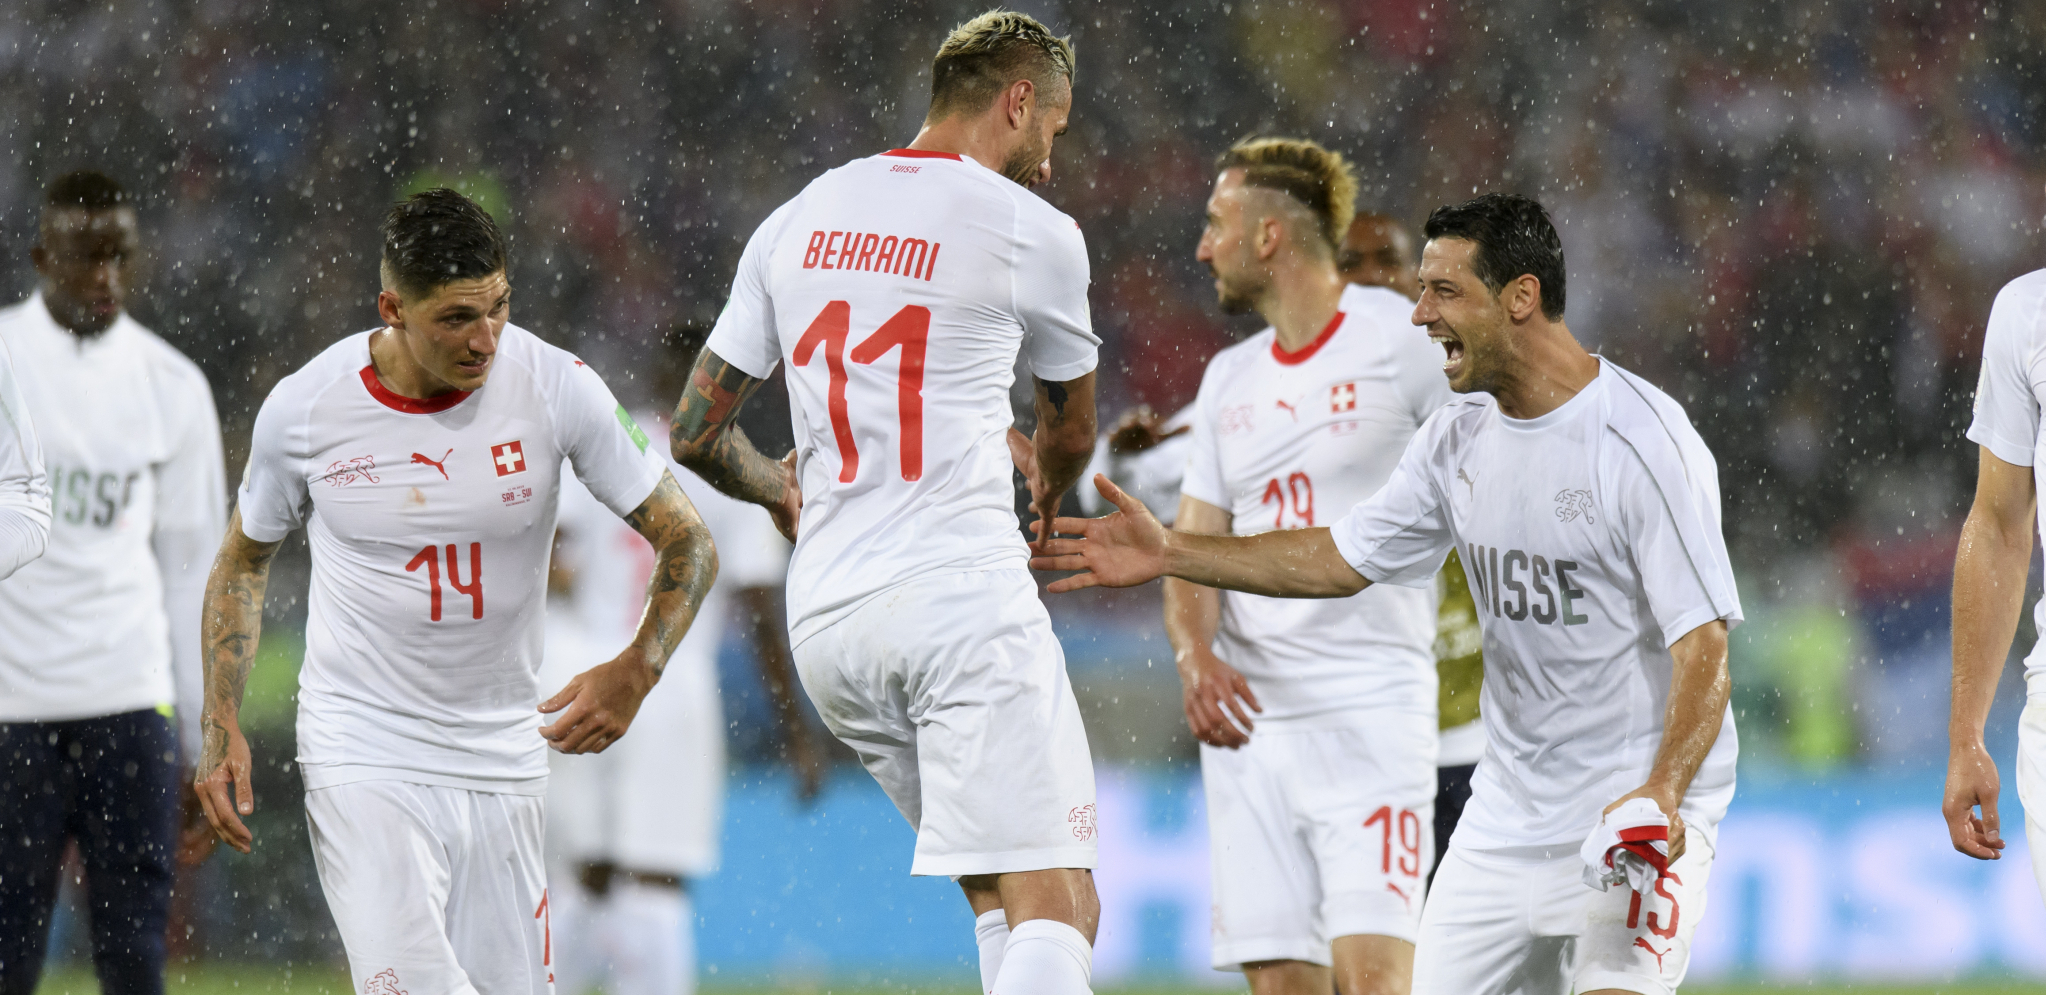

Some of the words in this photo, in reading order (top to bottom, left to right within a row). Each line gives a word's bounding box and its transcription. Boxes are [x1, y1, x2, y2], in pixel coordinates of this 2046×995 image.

[890, 164, 922, 174] SUISSE
[803, 231, 940, 281] BEHRAMI
[793, 300, 932, 484] 11
[501, 491, 515, 503] SRB
[521, 487, 533, 499] SUI
[1261, 471, 1315, 529] 19
[405, 541, 483, 622] 14
[1362, 804, 1420, 879] 19
[1612, 871, 1684, 941] 15
